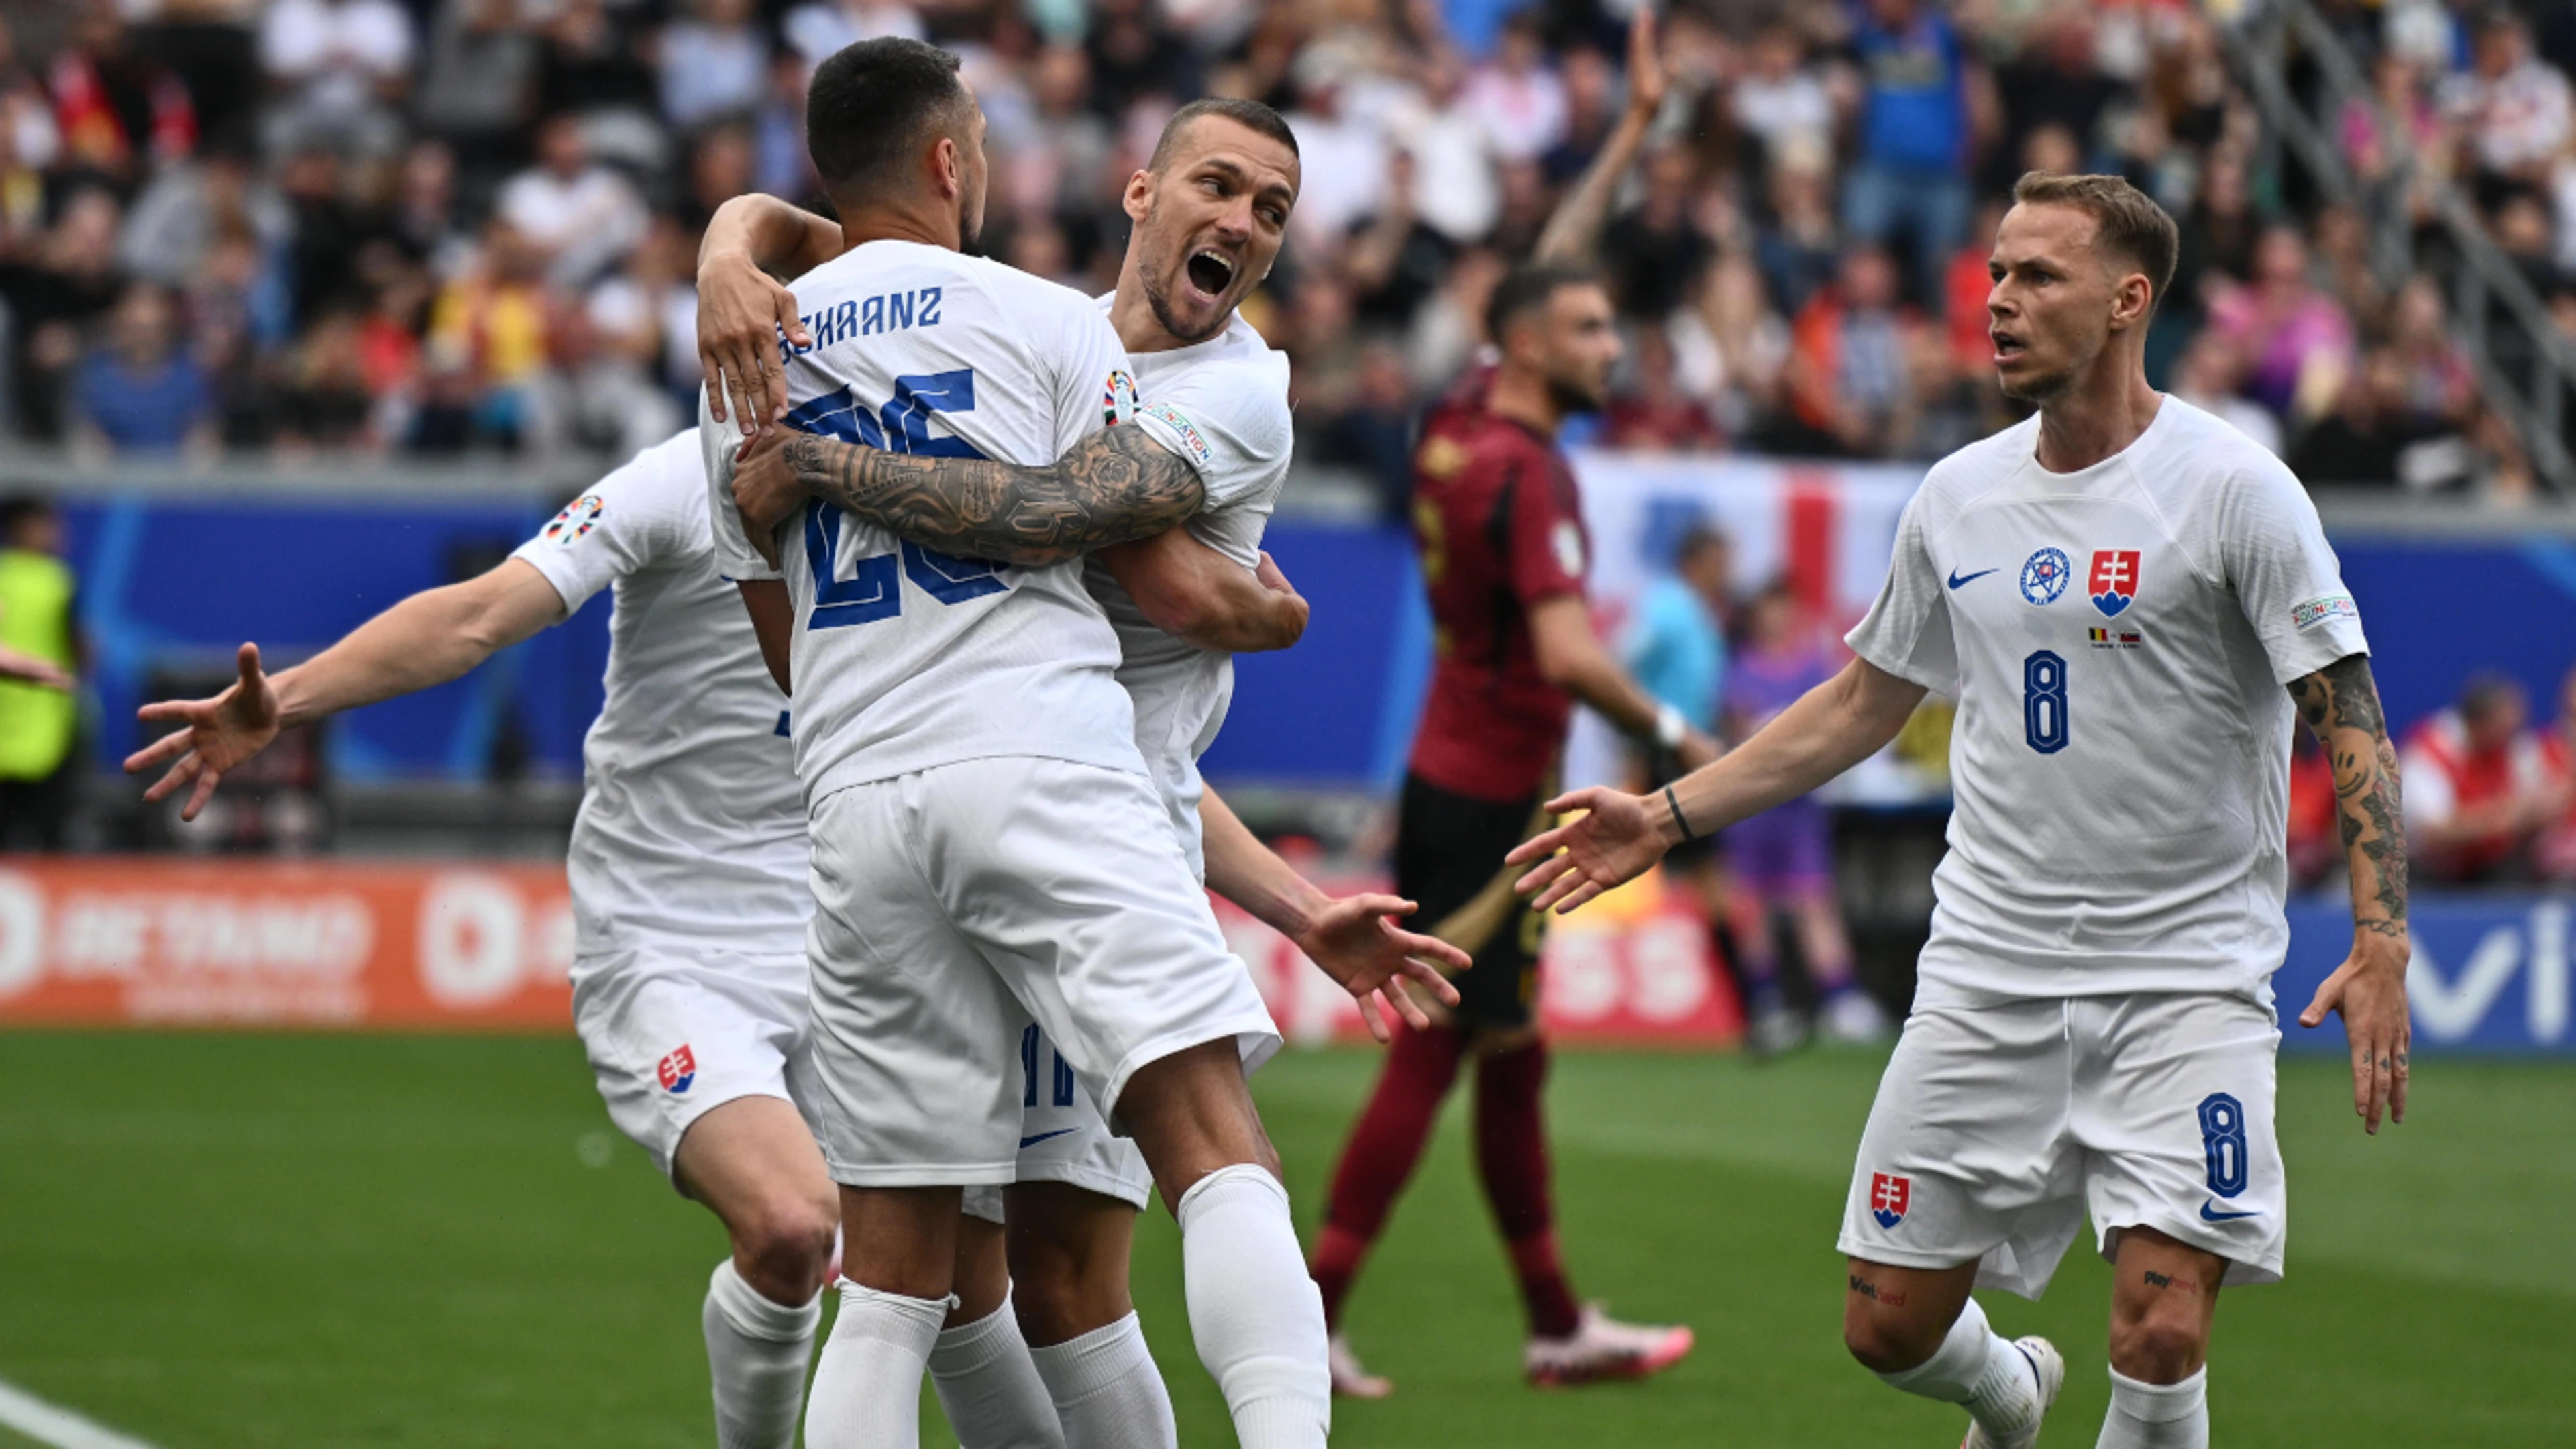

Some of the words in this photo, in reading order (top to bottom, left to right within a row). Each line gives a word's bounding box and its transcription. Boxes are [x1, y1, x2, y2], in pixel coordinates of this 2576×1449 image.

[2024, 650, 2069, 754] 8
[1021, 1021, 1074, 1107] 11
[2197, 1092, 2247, 1198] 8
